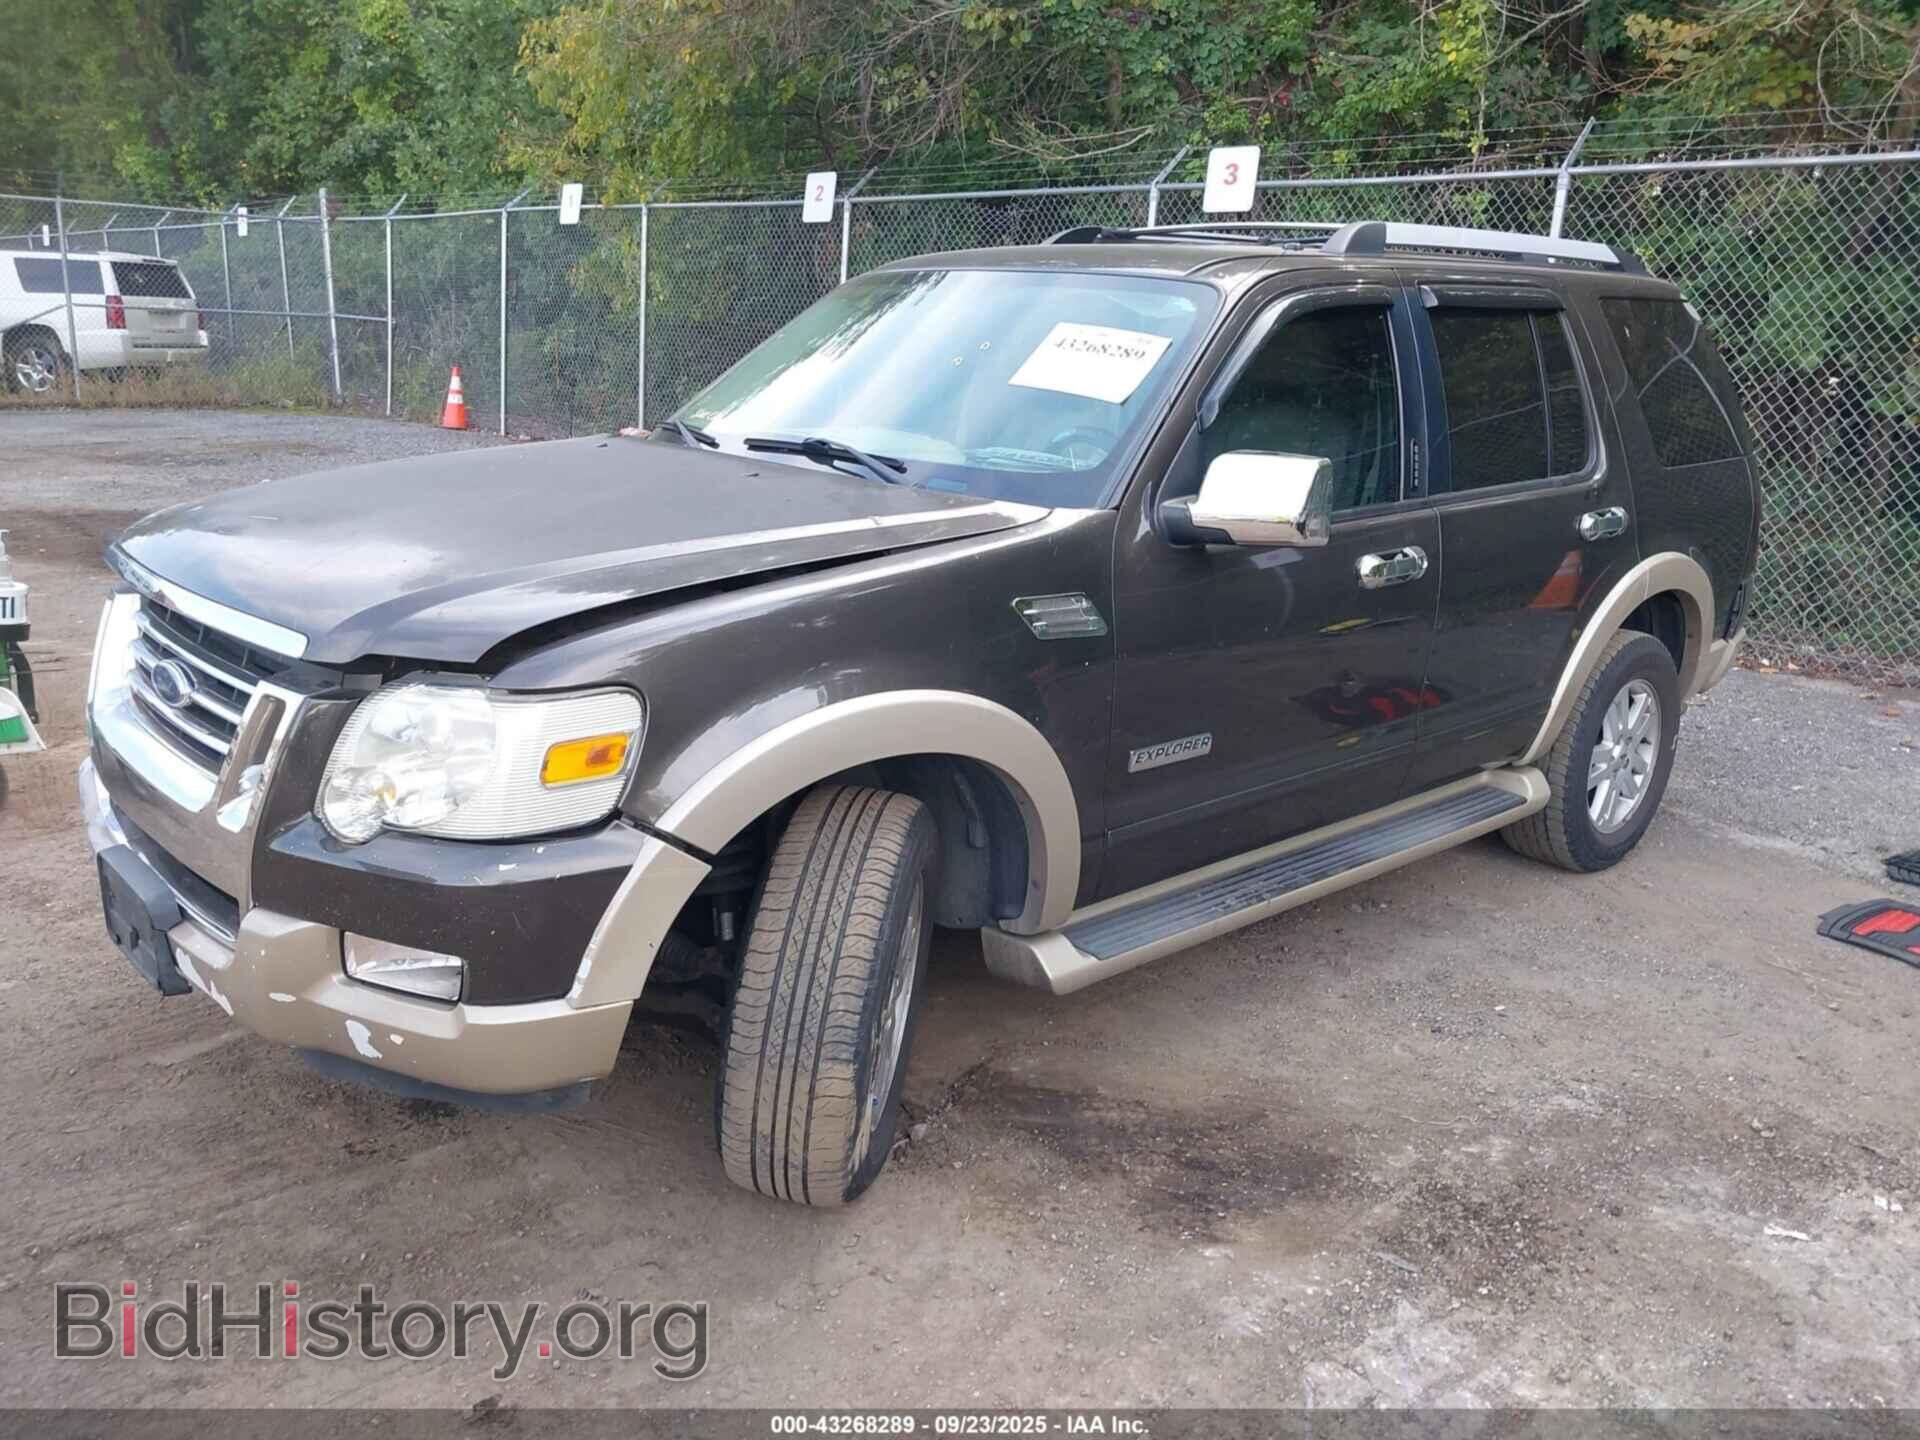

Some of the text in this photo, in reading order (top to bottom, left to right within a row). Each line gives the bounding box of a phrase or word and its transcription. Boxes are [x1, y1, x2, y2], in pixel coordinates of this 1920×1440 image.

[1223, 162, 1240, 186] 3
[814, 184, 825, 202] 2
[1135, 735, 1211, 764] EXPLORER
